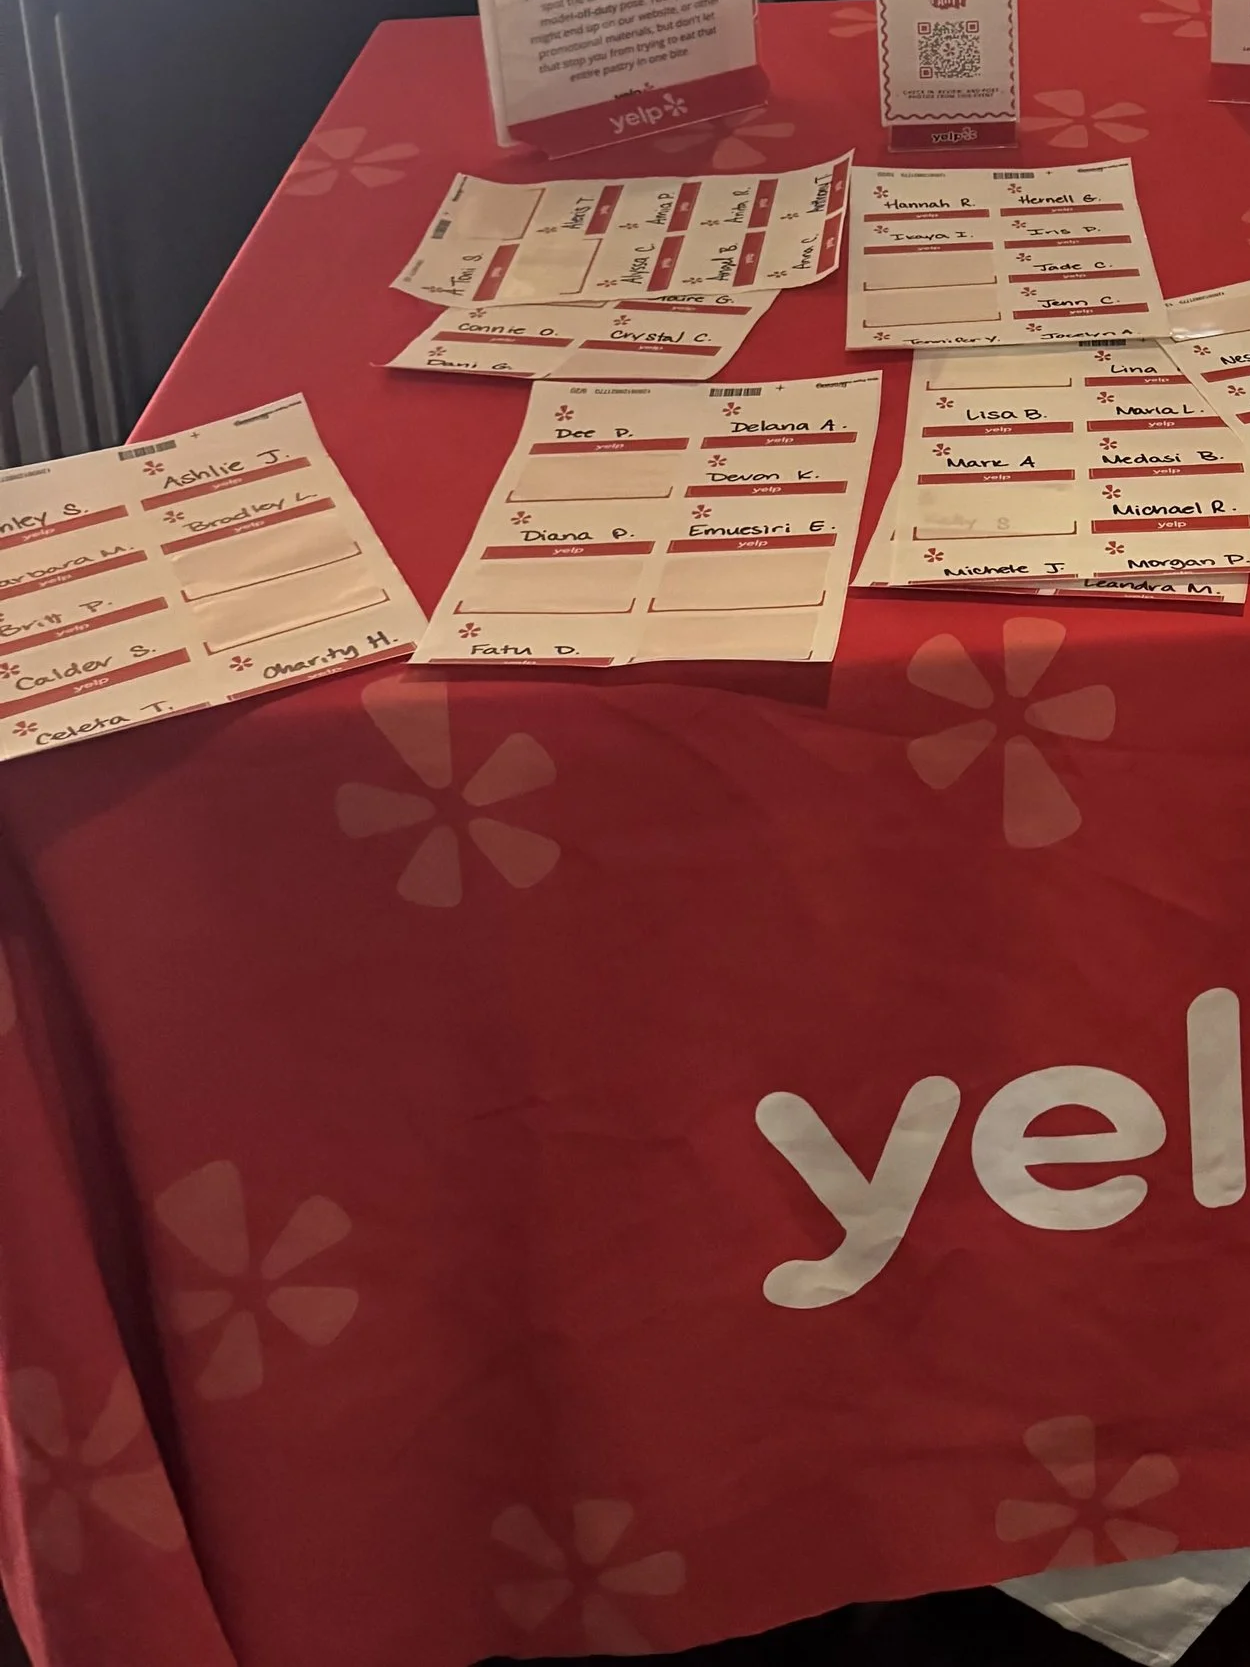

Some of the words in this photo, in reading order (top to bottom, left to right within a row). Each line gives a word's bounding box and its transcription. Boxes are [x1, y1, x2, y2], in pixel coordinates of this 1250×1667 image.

[540, 4, 617, 26] model-off-duty
[564, 25, 583, 37] end
[586, 23, 599, 33] up
[602, 19, 615, 28] on
[618, 15, 635, 26] our
[681, 4, 692, 13] or
[538, 36, 603, 61] promotional
[657, 19, 673, 31] but
[703, 12, 715, 21] let
[539, 60, 560, 74] that
[562, 57, 586, 70] stop
[588, 52, 607, 66] you
[610, 46, 634, 58] from
[636, 38, 665, 53] trying
[667, 34, 678, 44] to
[680, 32, 695, 42] eat
[697, 26, 717, 38] that
[603, 60, 635, 76] pastry
[637, 57, 647, 67] in
[649, 53, 667, 64] one
[609, 106, 663, 134] yelp
[884, 199, 950, 209] Hannah
[961, 198, 975, 207] R.
[1033, 263, 1082, 271] Jade
[1038, 299, 1088, 308] Jenn
[1100, 296, 1120, 304] C.
[458, 323, 526, 334] Connie
[610, 330, 686, 343] Crystal
[693, 333, 712, 342] C.
[427, 359, 478, 369] Dani
[1109, 364, 1158, 375] Lina
[966, 409, 1018, 421] Lisa
[1024, 409, 1048, 419] B.
[1115, 406, 1176, 416] Maria
[1182, 405, 1205, 413] L.
[555, 428, 596, 439] Dee
[730, 420, 810, 434] Delana
[819, 419, 847, 432] A.
[946, 457, 1009, 469] Mark
[1019, 455, 1036, 468] A
[1196, 451, 1224, 462] B.
[163, 460, 245, 489] Ashlie
[257, 449, 290, 464] J.
[705, 471, 780, 482] Devon
[797, 470, 819, 479] K.
[63, 503, 89, 517] S.
[182, 498, 285, 532] Bradley
[1112, 502, 1202, 517] Michael
[1211, 499, 1237, 514] R.
[809, 521, 836, 532] E.
[1158, 521, 1187, 529] yelp
[520, 529, 594, 542] Diana
[612, 528, 635, 540] P.
[0, 555, 94, 586] arbara
[100, 546, 135, 558] M.
[1127, 556, 1216, 570] Morgan
[1224, 554, 1250, 565] P.
[943, 563, 1029, 578] Michele
[1044, 563, 1065, 574] J.
[1083, 579, 1176, 594] Leandra
[1187, 583, 1221, 595] M.
[78, 600, 113, 613] P.
[263, 644, 359, 679] Charity
[366, 630, 399, 649] H.
[470, 643, 533, 656] Fatu
[553, 645, 580, 656] D.
[15, 655, 113, 691] Calder
[129, 645, 157, 658] S.
[73, 676, 110, 694] yelp
[140, 700, 174, 714] T.
